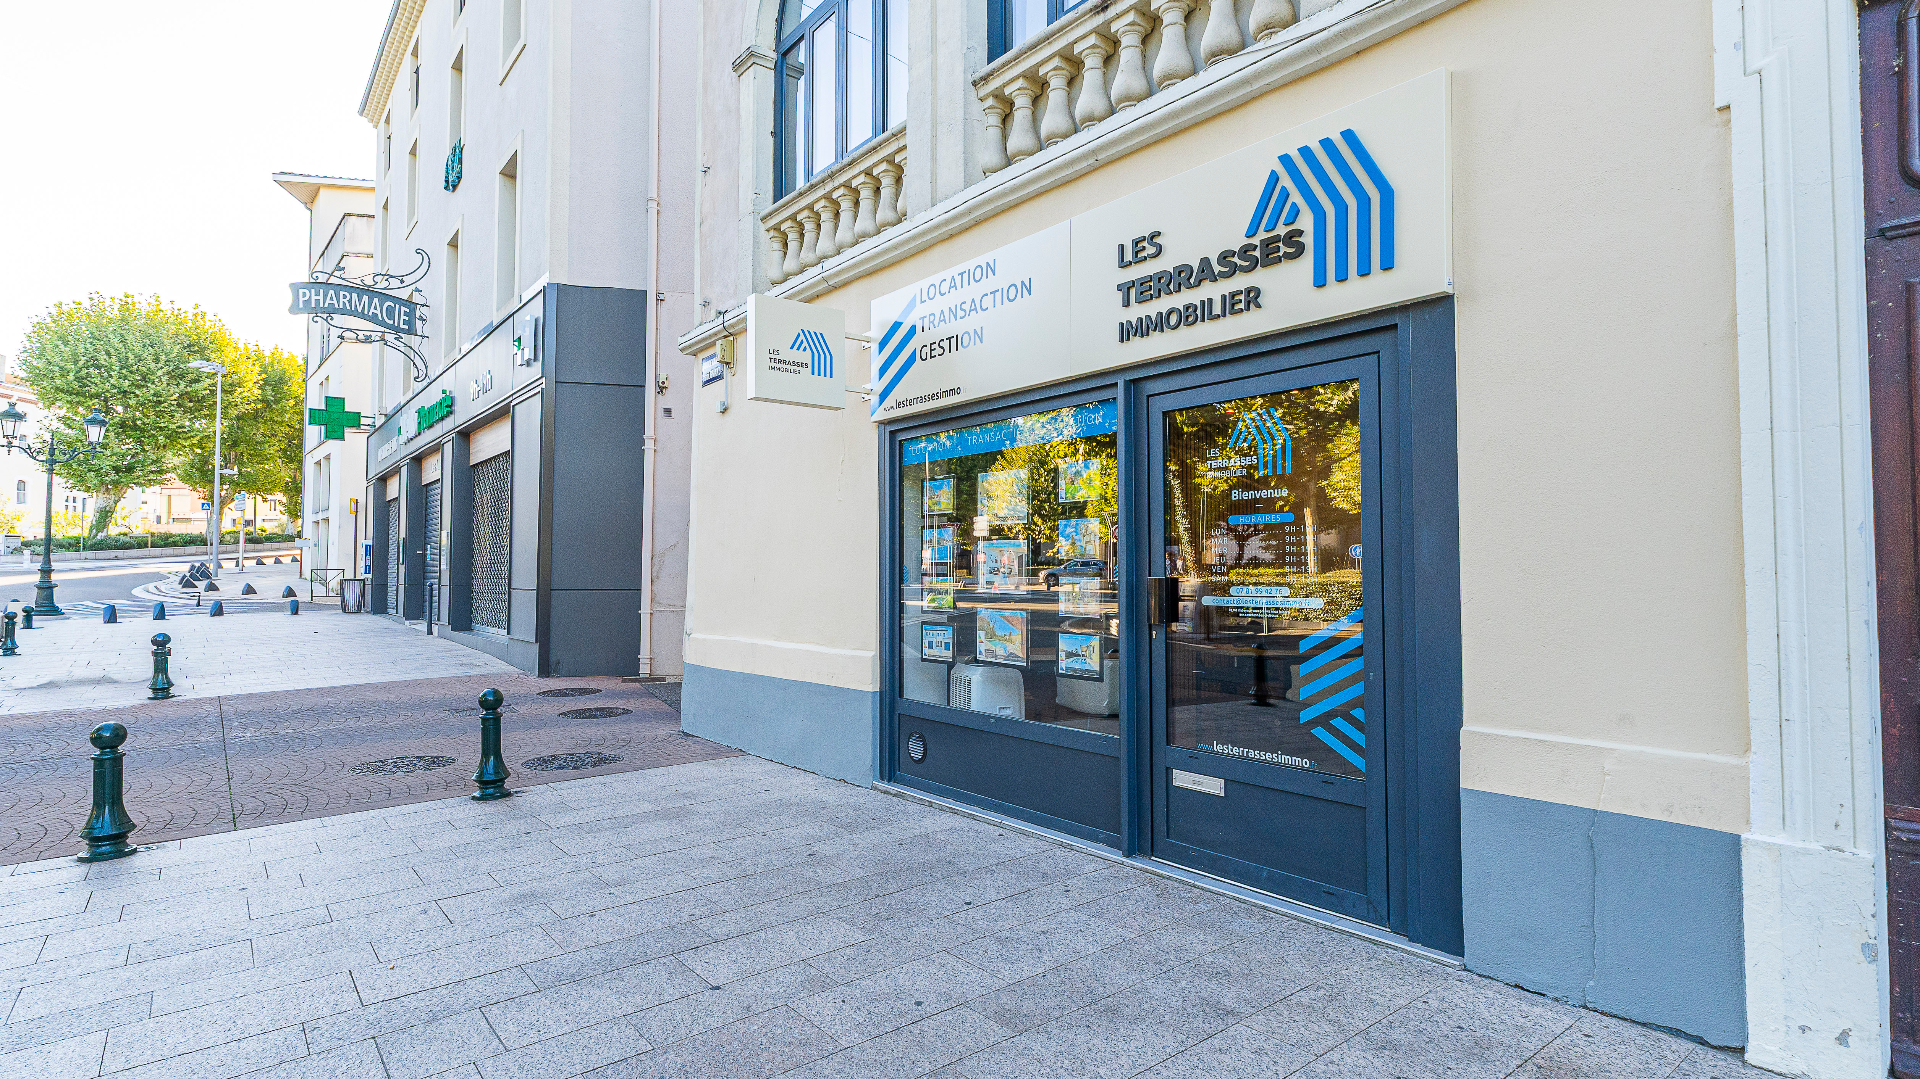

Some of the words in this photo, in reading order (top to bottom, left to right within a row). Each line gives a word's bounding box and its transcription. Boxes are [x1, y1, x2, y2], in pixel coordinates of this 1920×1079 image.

[1116, 229, 1163, 268] LES
[1116, 228, 1306, 308] TERRASSES
[919, 258, 997, 304] LOCATION
[298, 288, 410, 330] PHARMACIE
[919, 278, 1033, 333] TRANSACTION
[1117, 285, 1263, 343] IMMOBILIER
[919, 325, 985, 362] GESTION
[768, 348, 780, 356] LES
[768, 356, 809, 369] TERRASSES
[768, 365, 801, 375] IMMOBILIER
[1206, 448, 1221, 457] LES
[1206, 455, 1258, 469] TERRASSES
[1206, 468, 1248, 479] IMMOBILIER
[1231, 488, 1289, 501] Bienvenue
[1239, 514, 1281, 523] HORAIRES
[1211, 528, 1227, 536] LUN
[1211, 537, 1228, 545] MAR
[1211, 546, 1228, 554] MER
[1212, 556, 1226, 564] JEU
[1211, 565, 1227, 573] VEN
[1235, 587, 1244, 595] 07
[1255, 587, 1263, 595] 99
[1264, 587, 1273, 595] 42
[1196, 740, 1318, 769] www.lesterrassesimmo.fr
